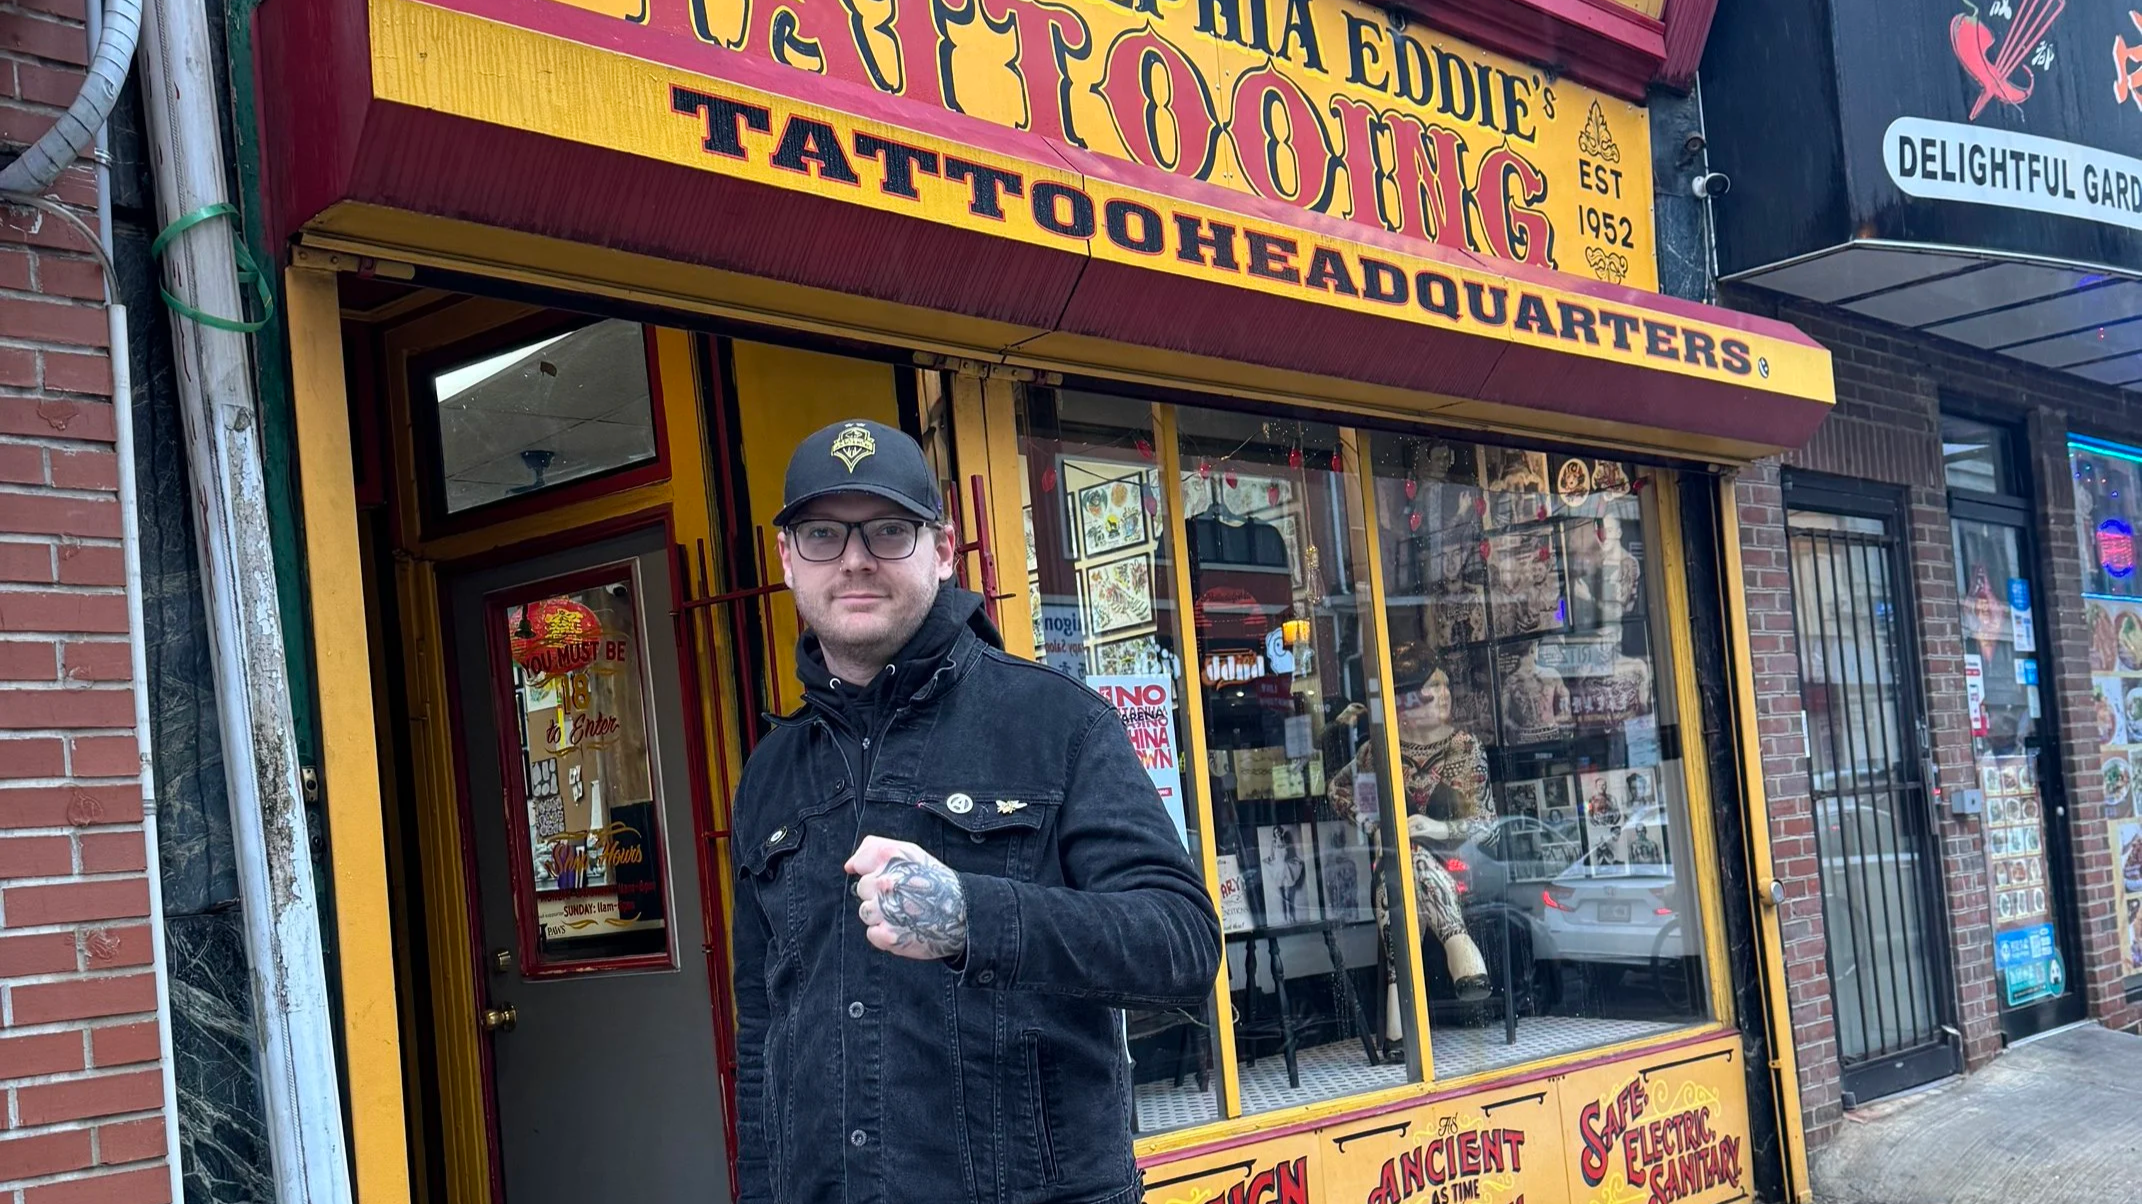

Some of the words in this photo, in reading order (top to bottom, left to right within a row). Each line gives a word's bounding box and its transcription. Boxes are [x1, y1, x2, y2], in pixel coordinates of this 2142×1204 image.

[1578, 158, 1623, 200] EST
[1898, 134, 2077, 200] DELIGHTFUL
[2083, 163, 2142, 214] GARD
[1578, 204, 1635, 249] 1952
[522, 653, 551, 679] YOU
[556, 640, 600, 668] MUST
[605, 640, 627, 662] BE
[562, 672, 591, 716] 18
[1115, 684, 1167, 707] NO
[546, 716, 562, 744] to
[570, 711, 620, 746] Enter
[1121, 707, 1166, 726] ARENA
[1127, 727, 1171, 750] HINA
[598, 838, 643, 868] Hours
[563, 902, 597, 918] SUNDAY:
[547, 924, 567, 936] PAWS
[1367, 1128, 1525, 1204] ANCIENT
[1431, 1188, 1449, 1204] AS
[1450, 1178, 1481, 1200] TIME
